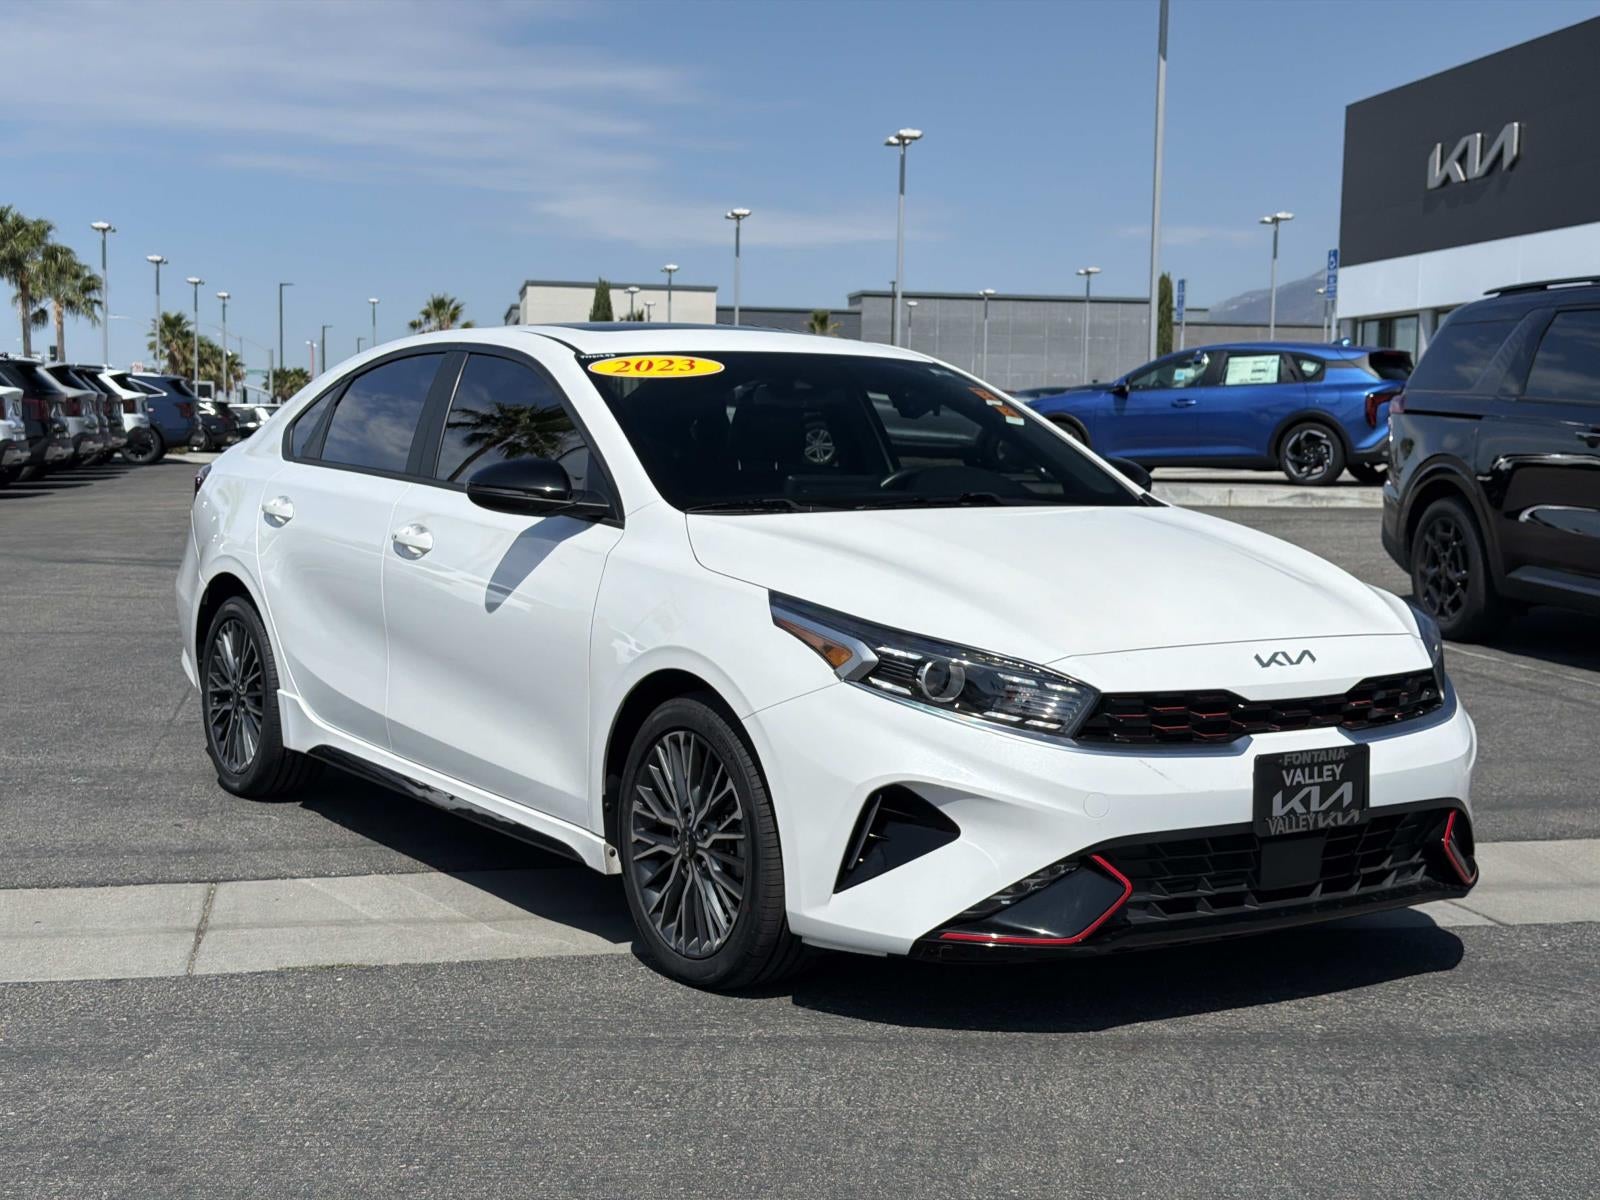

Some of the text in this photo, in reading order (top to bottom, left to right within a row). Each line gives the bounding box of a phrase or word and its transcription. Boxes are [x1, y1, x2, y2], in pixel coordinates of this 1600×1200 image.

[1427, 122, 1518, 189] KIA
[613, 359, 696, 373] 2023
[1254, 649, 1316, 668] KIA
[1282, 763, 1344, 787] VALLEY
[1272, 781, 1353, 817] KIA
[1266, 808, 1360, 835] VALLEY KIA
